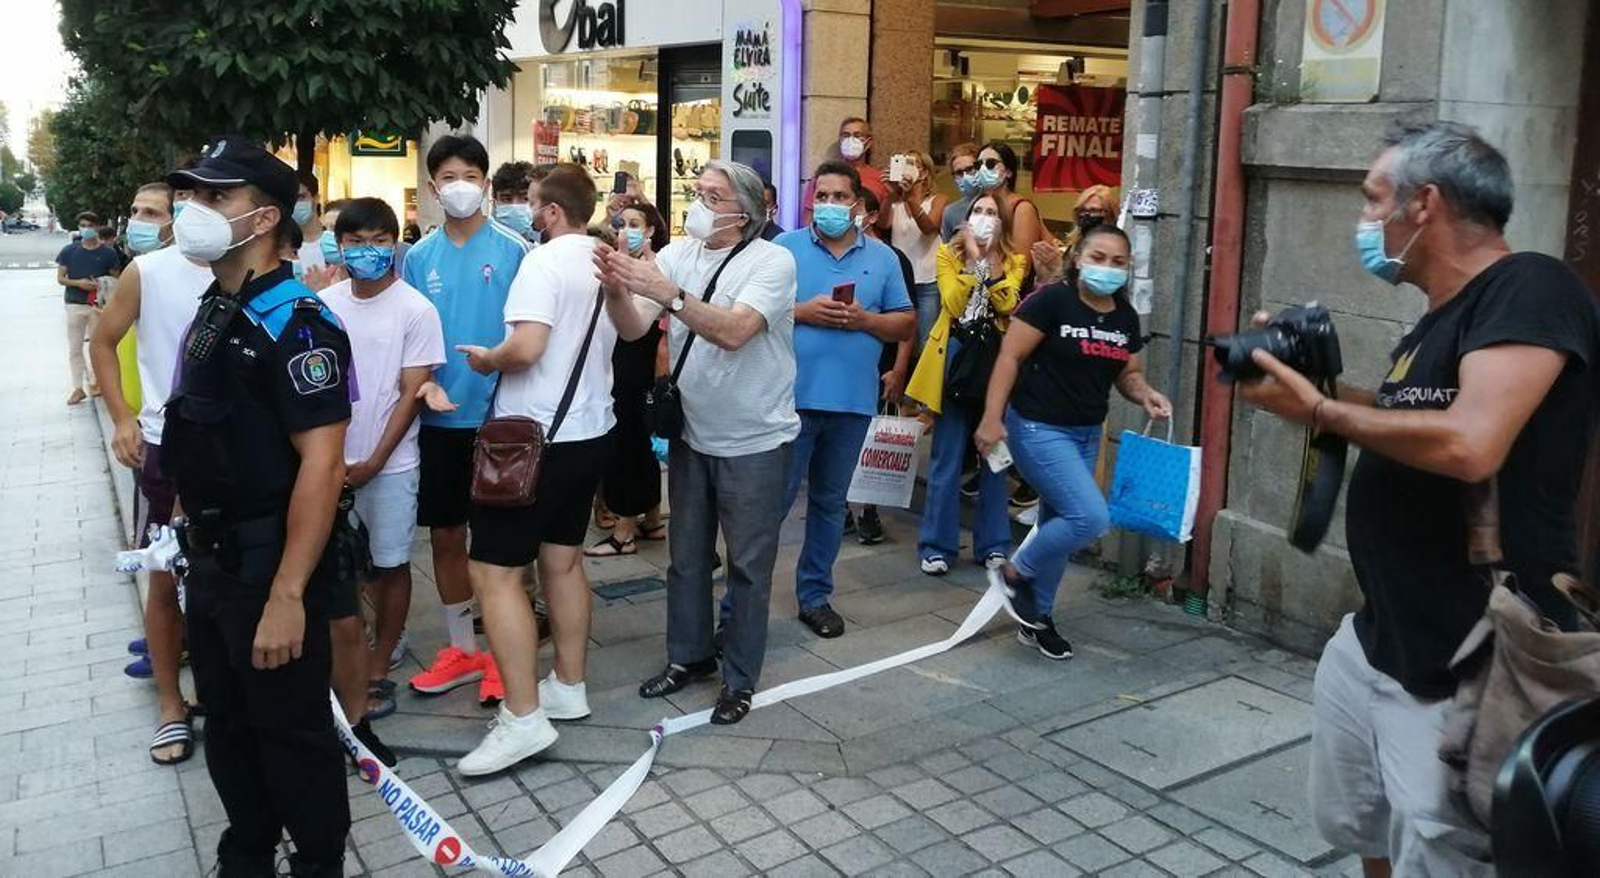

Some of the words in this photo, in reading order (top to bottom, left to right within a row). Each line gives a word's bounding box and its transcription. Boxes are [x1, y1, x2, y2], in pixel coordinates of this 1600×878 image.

[733, 46, 771, 70] ELVIRA
[732, 82, 771, 118] Suite
[1042, 114, 1121, 134] REMATE
[1041, 134, 1119, 158] FINAL
[1060, 325, 1089, 338] Pra
[377, 778, 398, 807] NO
[399, 797, 441, 846] PASAR
